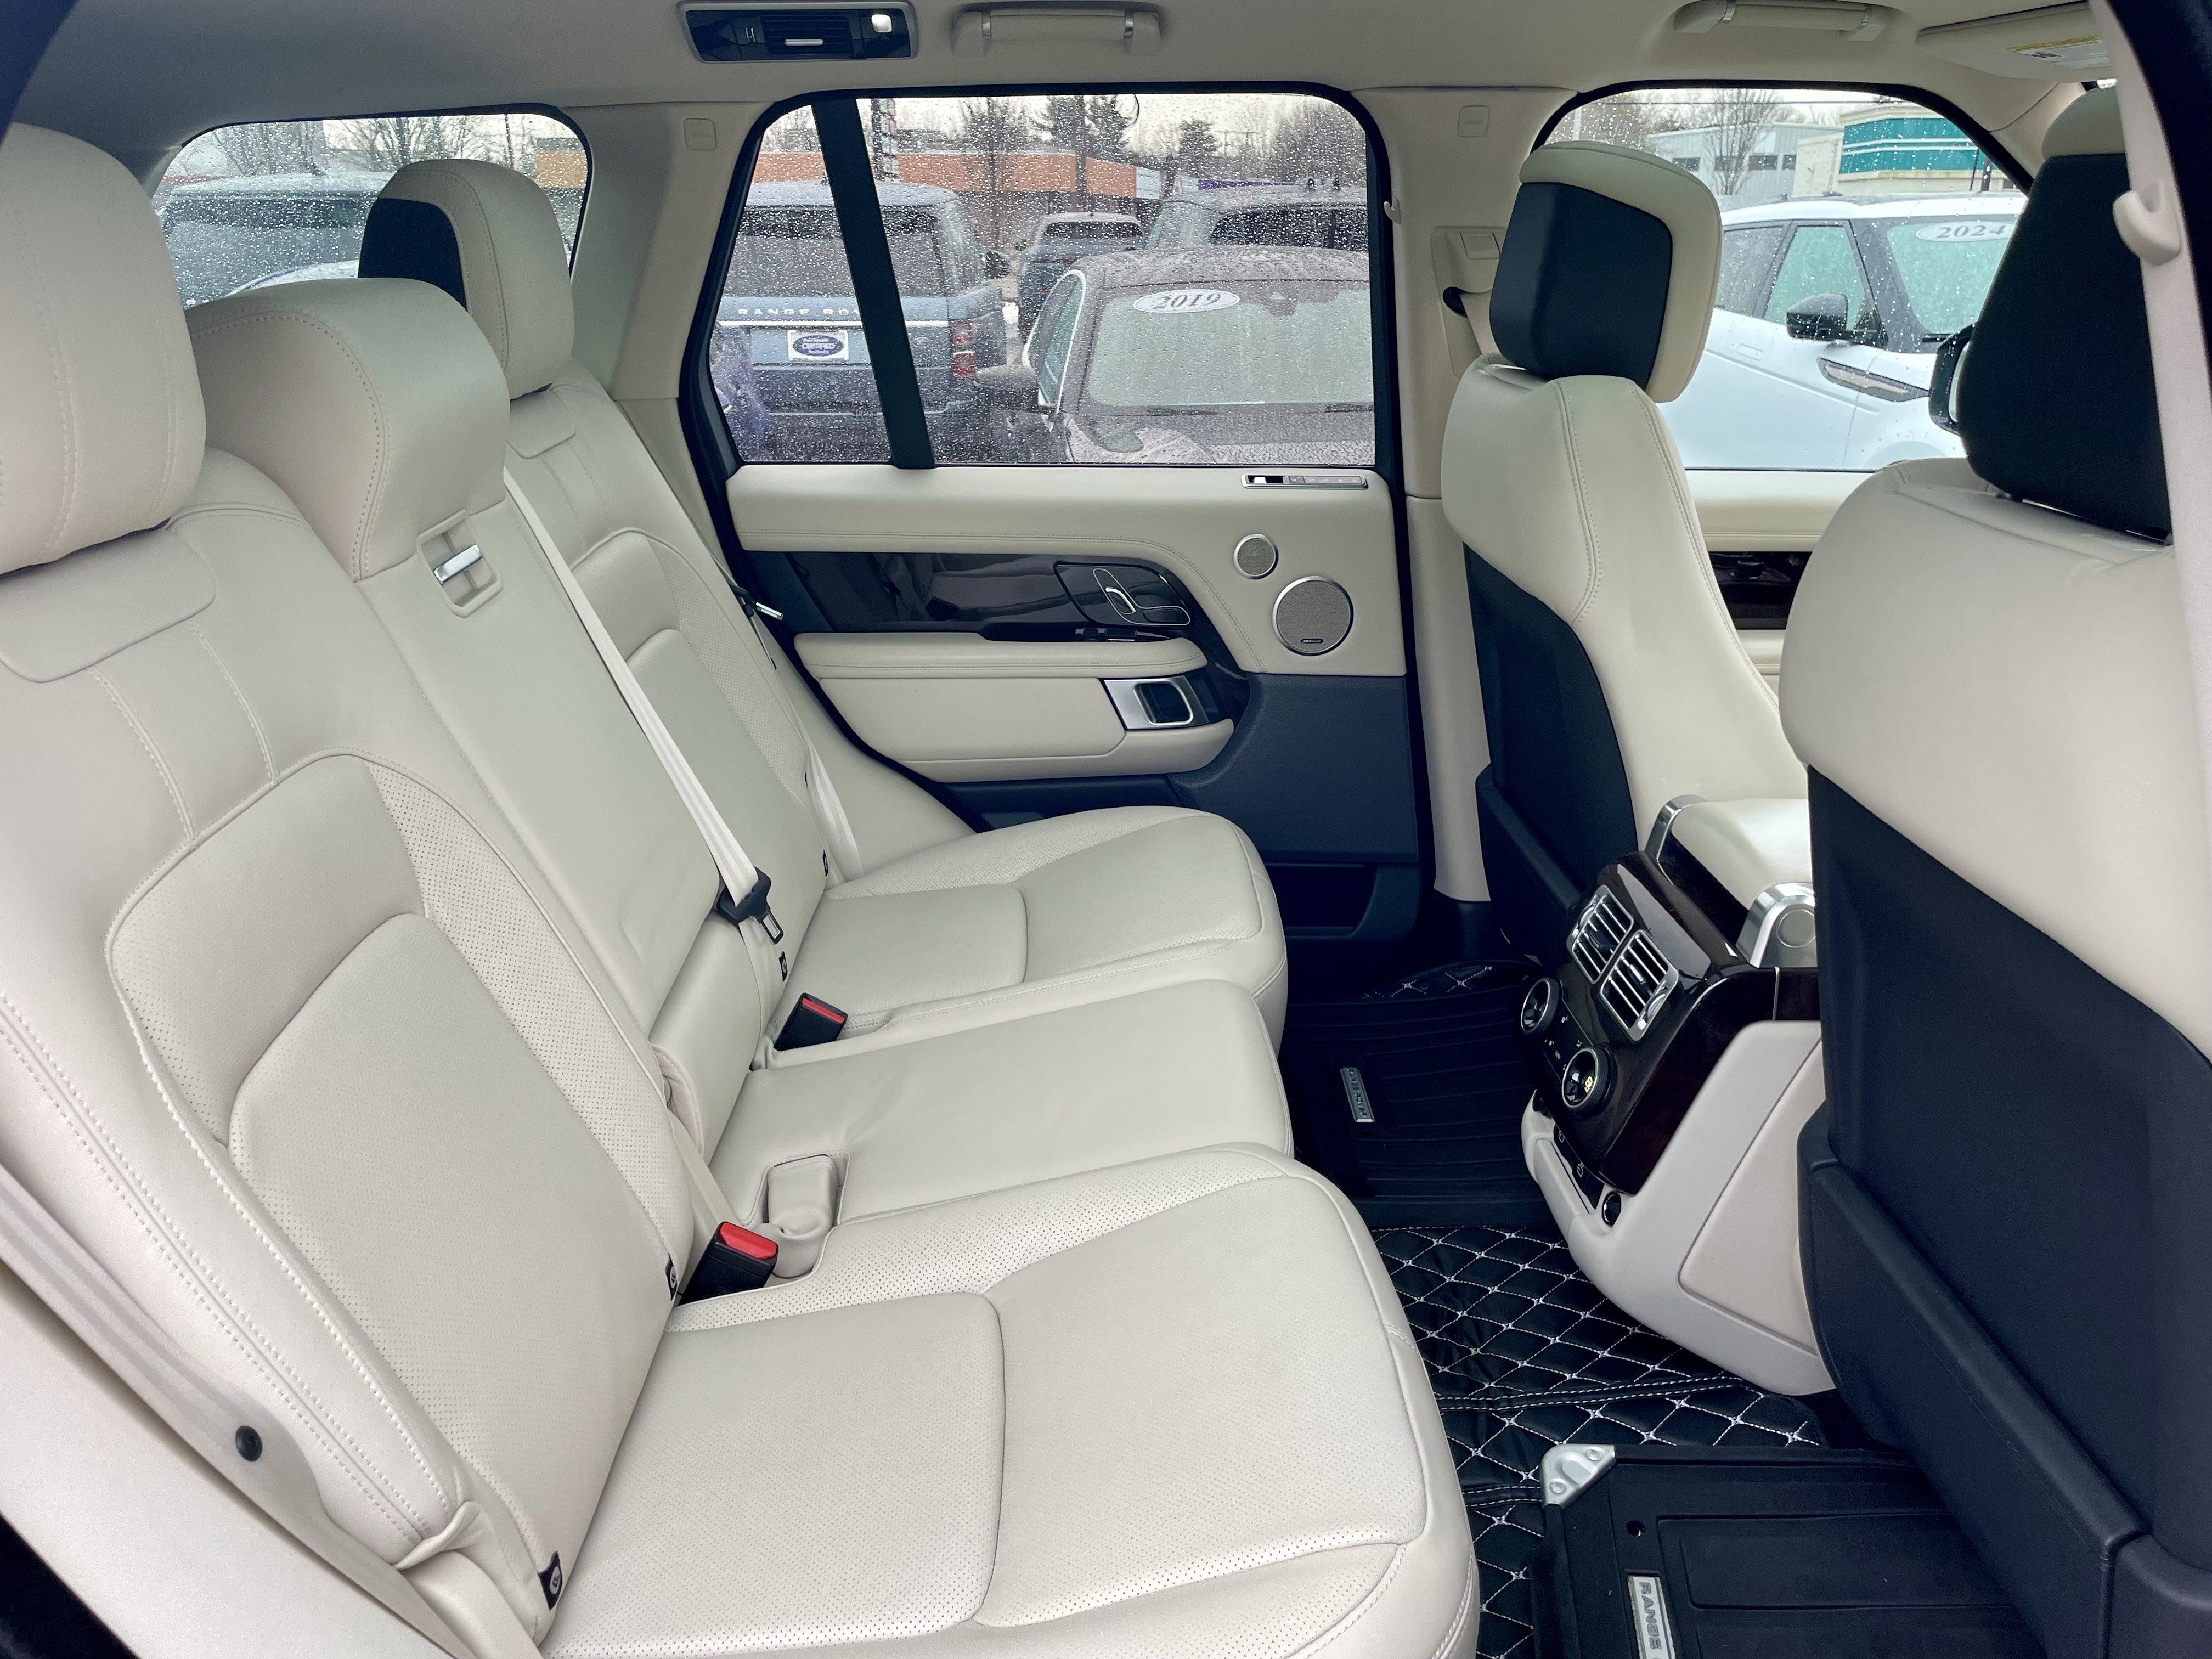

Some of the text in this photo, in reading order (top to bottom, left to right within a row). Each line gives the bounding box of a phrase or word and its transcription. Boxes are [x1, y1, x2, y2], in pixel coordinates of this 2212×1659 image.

[1936, 224, 2006, 239] 2024
[1152, 293, 1221, 309] 2019
[1639, 1582, 1662, 1650] RANGE
